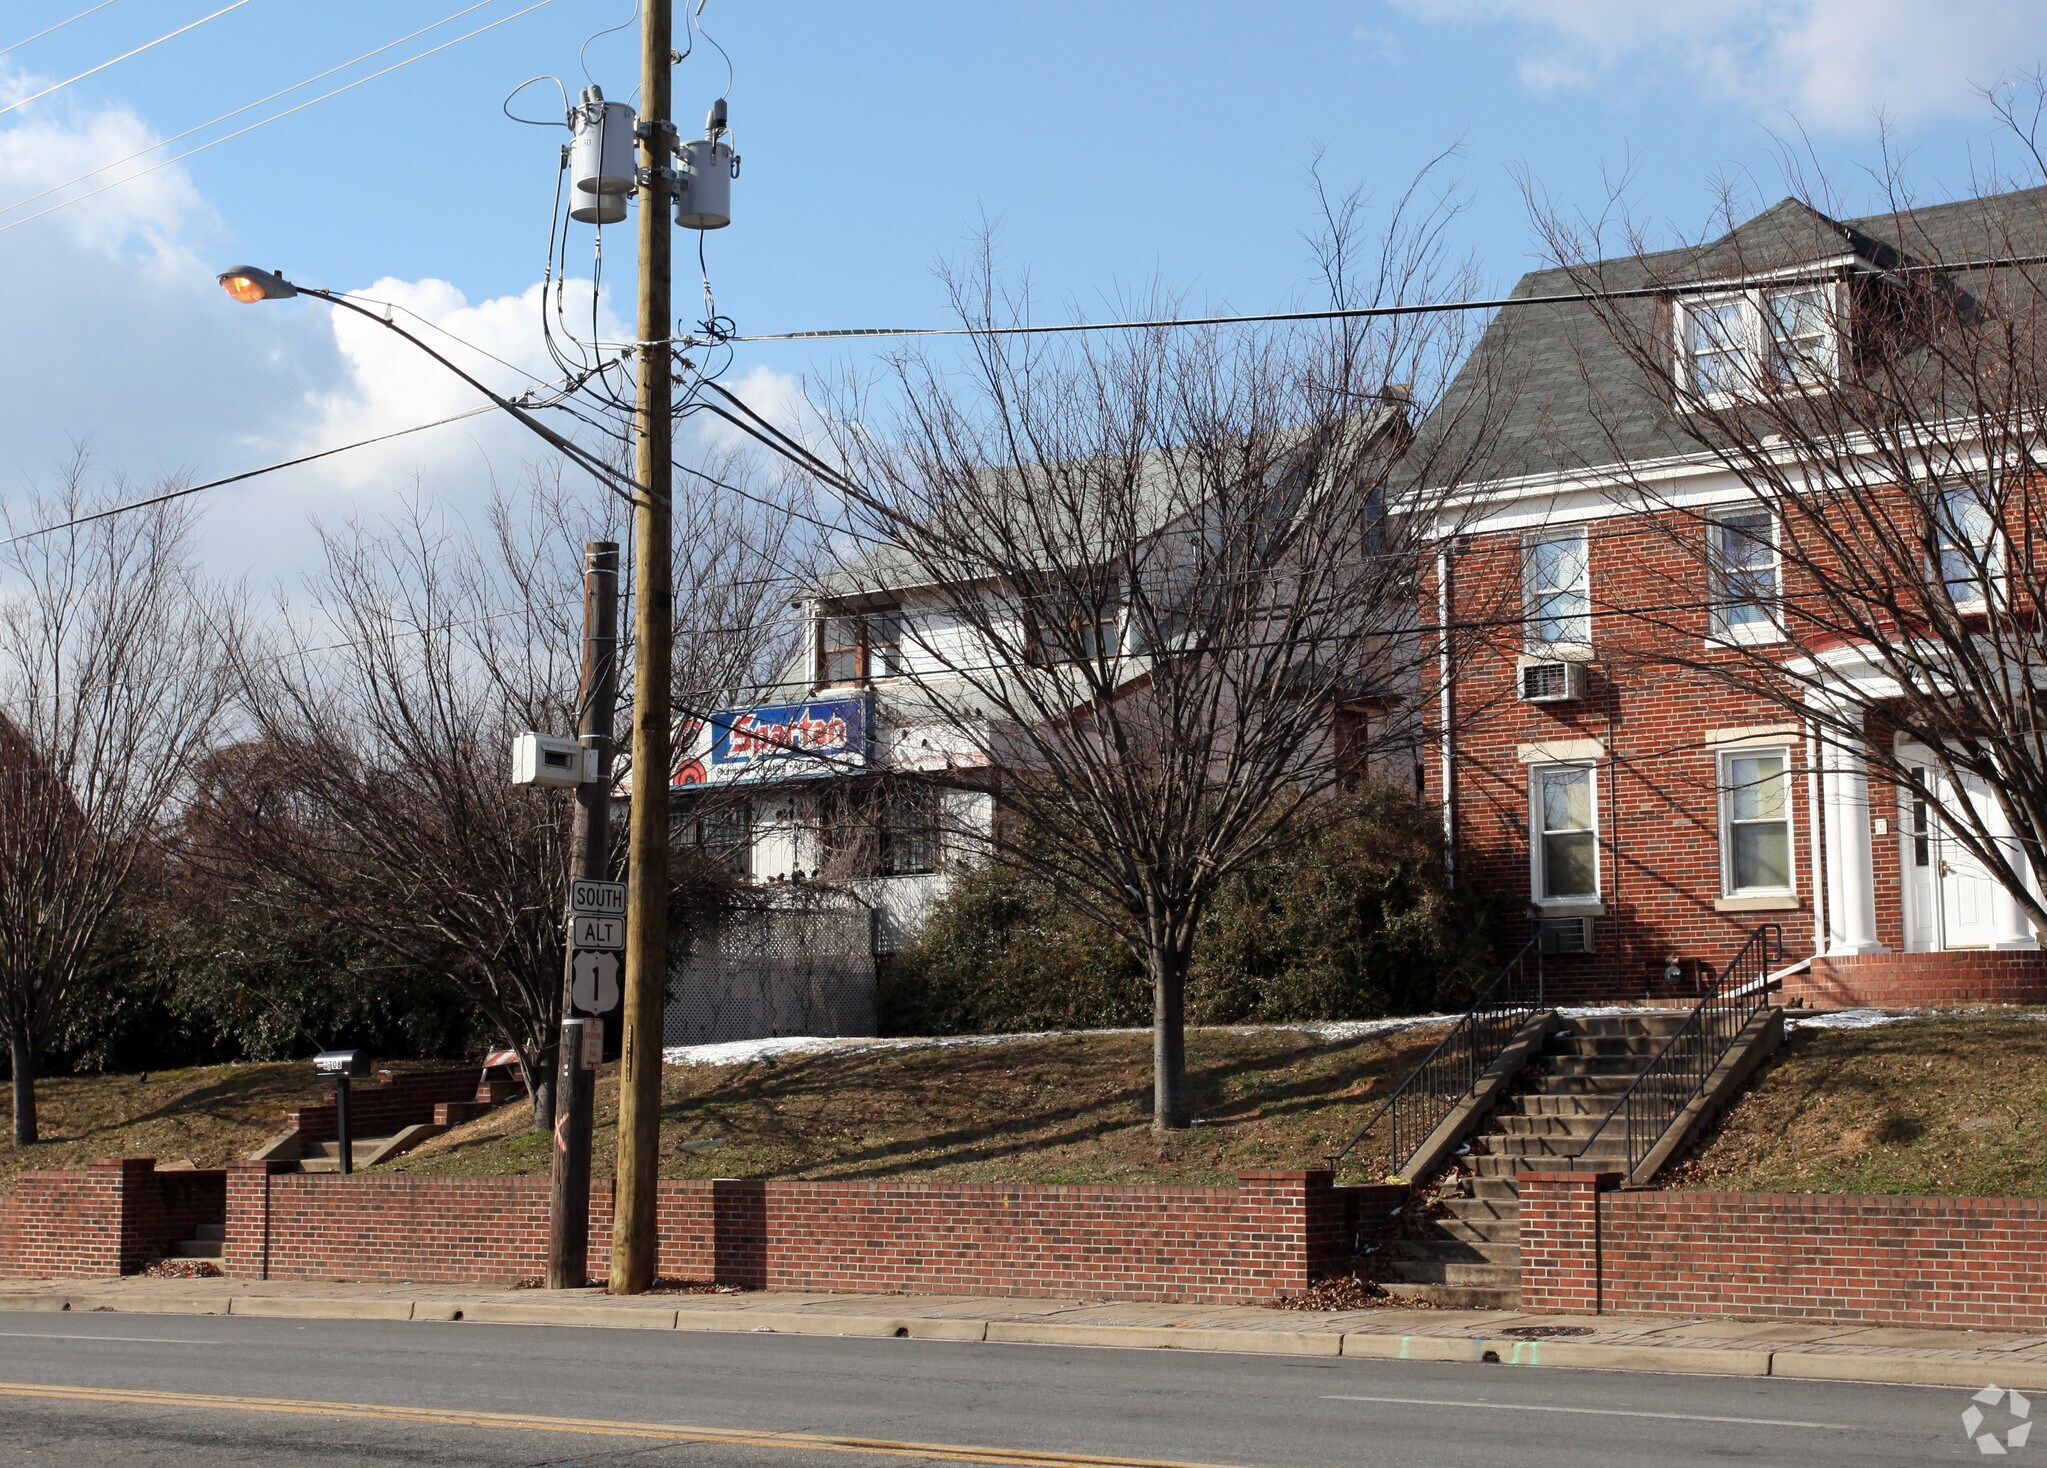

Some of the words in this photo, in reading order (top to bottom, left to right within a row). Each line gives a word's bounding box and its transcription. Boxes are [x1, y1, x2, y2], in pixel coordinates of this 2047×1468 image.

[726, 707, 847, 758] Spartan
[716, 766, 750, 777] Plumbg
[577, 887, 622, 908] SOUTH
[585, 923, 613, 941] ALT
[592, 966, 599, 1001] 1
